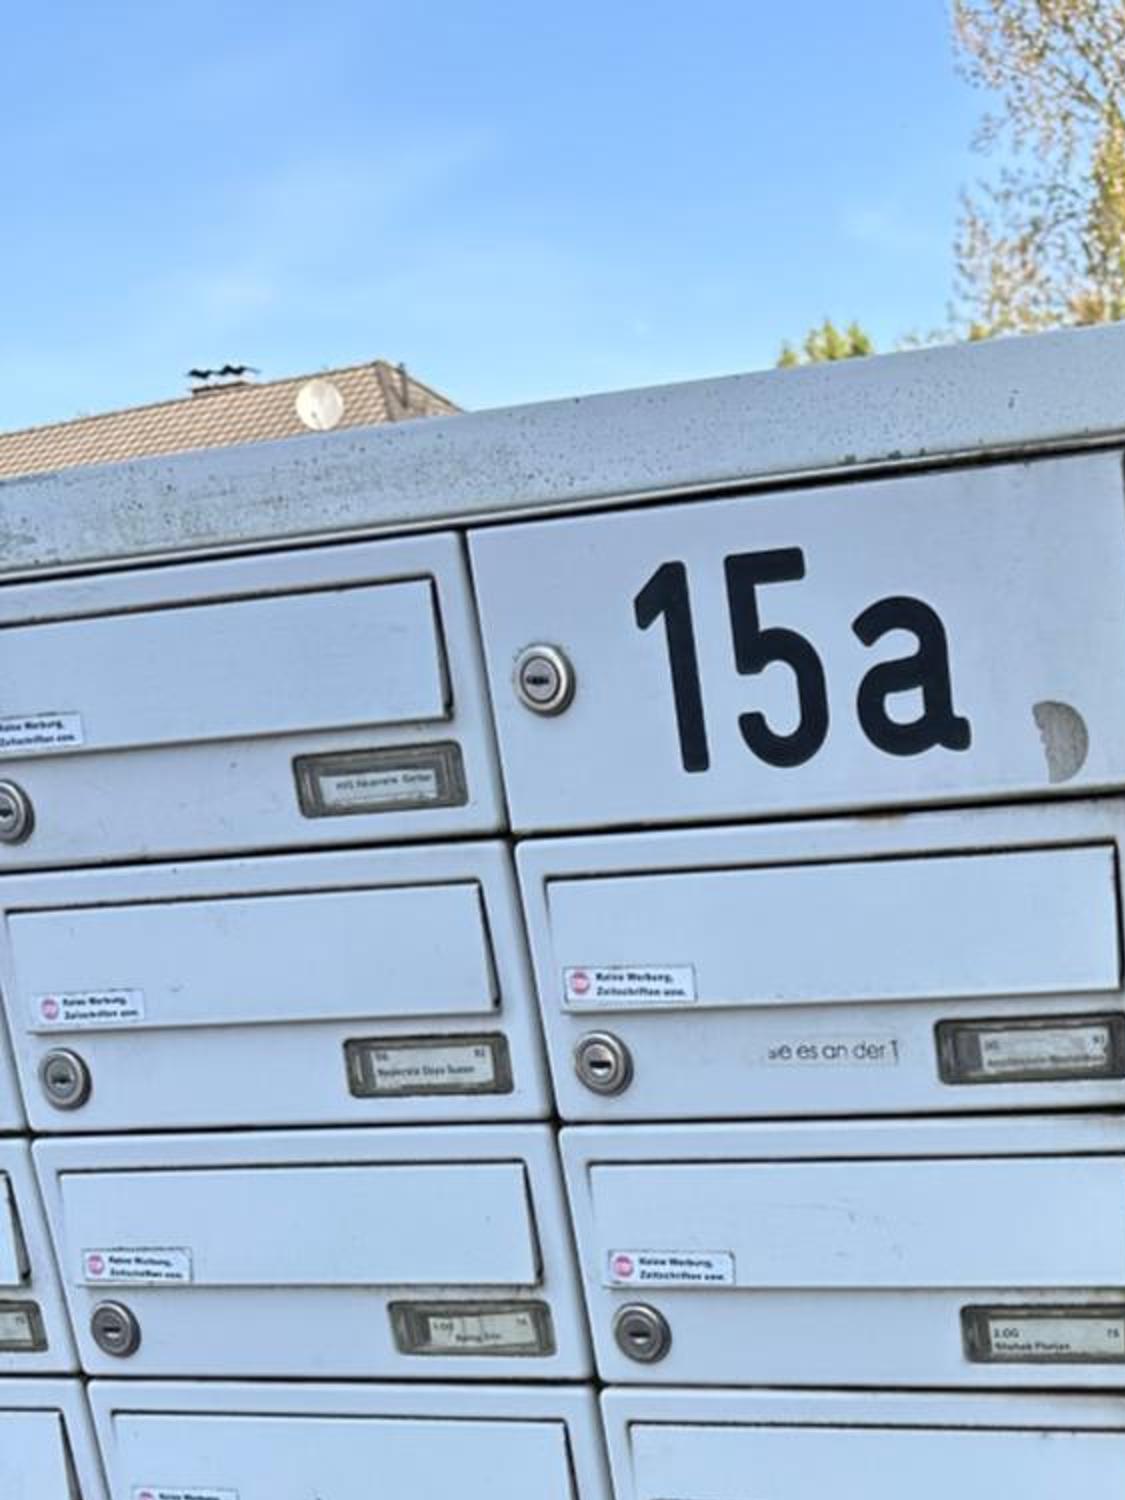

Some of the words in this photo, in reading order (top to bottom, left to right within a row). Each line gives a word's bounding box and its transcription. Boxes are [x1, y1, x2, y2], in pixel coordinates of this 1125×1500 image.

[632, 546, 971, 773] 15a
[596, 973, 624, 982] Keine
[630, 973, 673, 983] Werbung,
[796, 1044, 818, 1060] es
[822, 1044, 848, 1060] an
[853, 1040, 885, 1060] der
[639, 1258, 666, 1266] Keine
[670, 1258, 712, 1268] Werbung,
